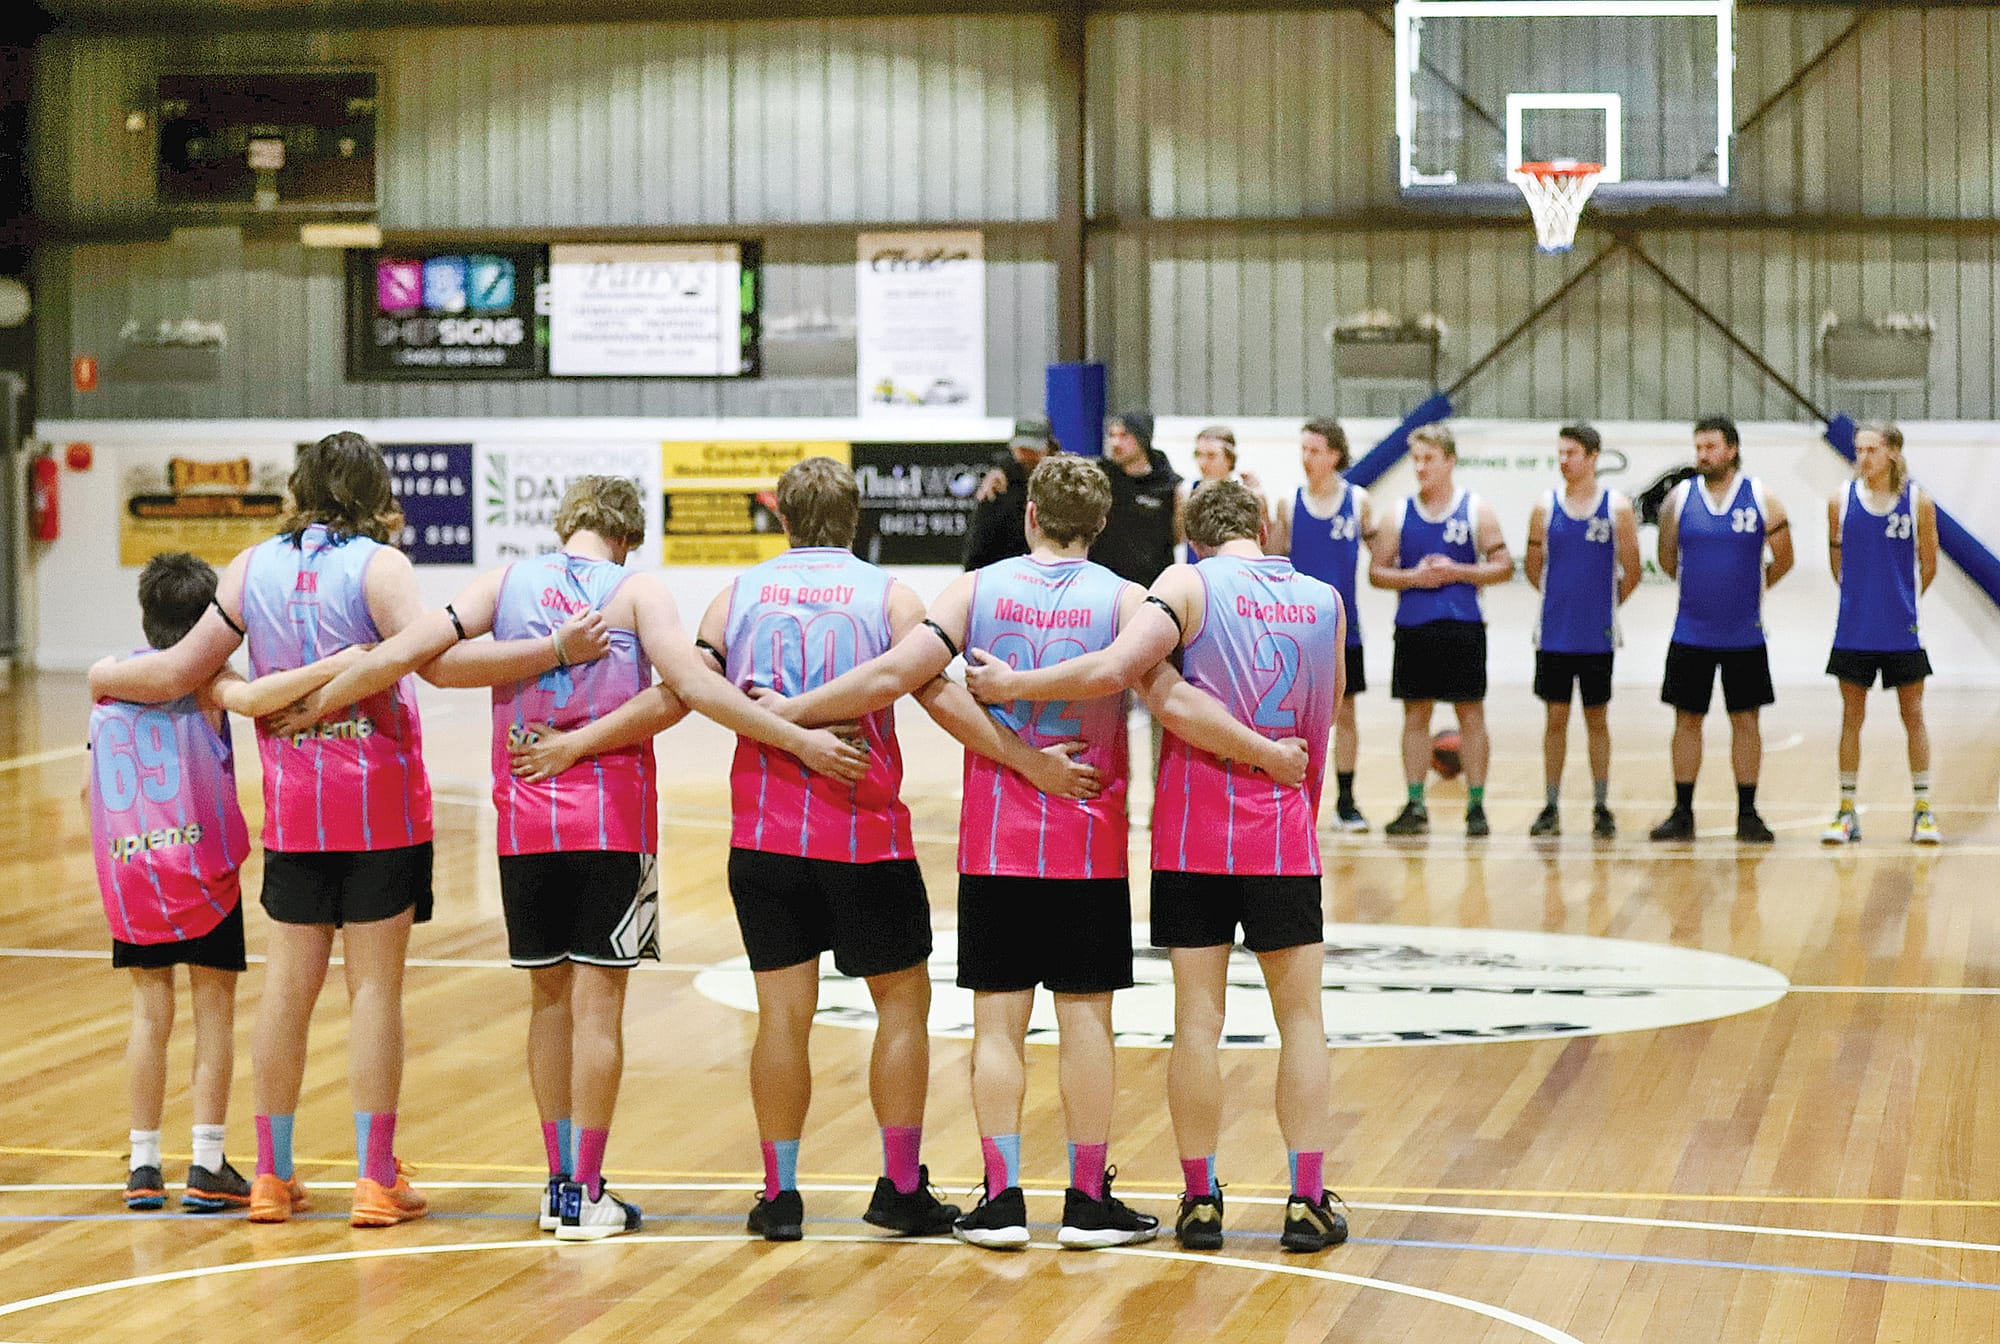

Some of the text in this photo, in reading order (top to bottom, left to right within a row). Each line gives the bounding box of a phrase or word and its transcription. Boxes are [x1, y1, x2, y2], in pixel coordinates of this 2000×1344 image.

[1731, 506, 1758, 534] 32
[1884, 512, 1912, 540] 23
[759, 583, 855, 606] Big Booty
[1235, 594, 1317, 624] Crackers
[750, 611, 859, 698] 00
[1252, 631, 1301, 728] 2
[97, 706, 181, 814] 69
